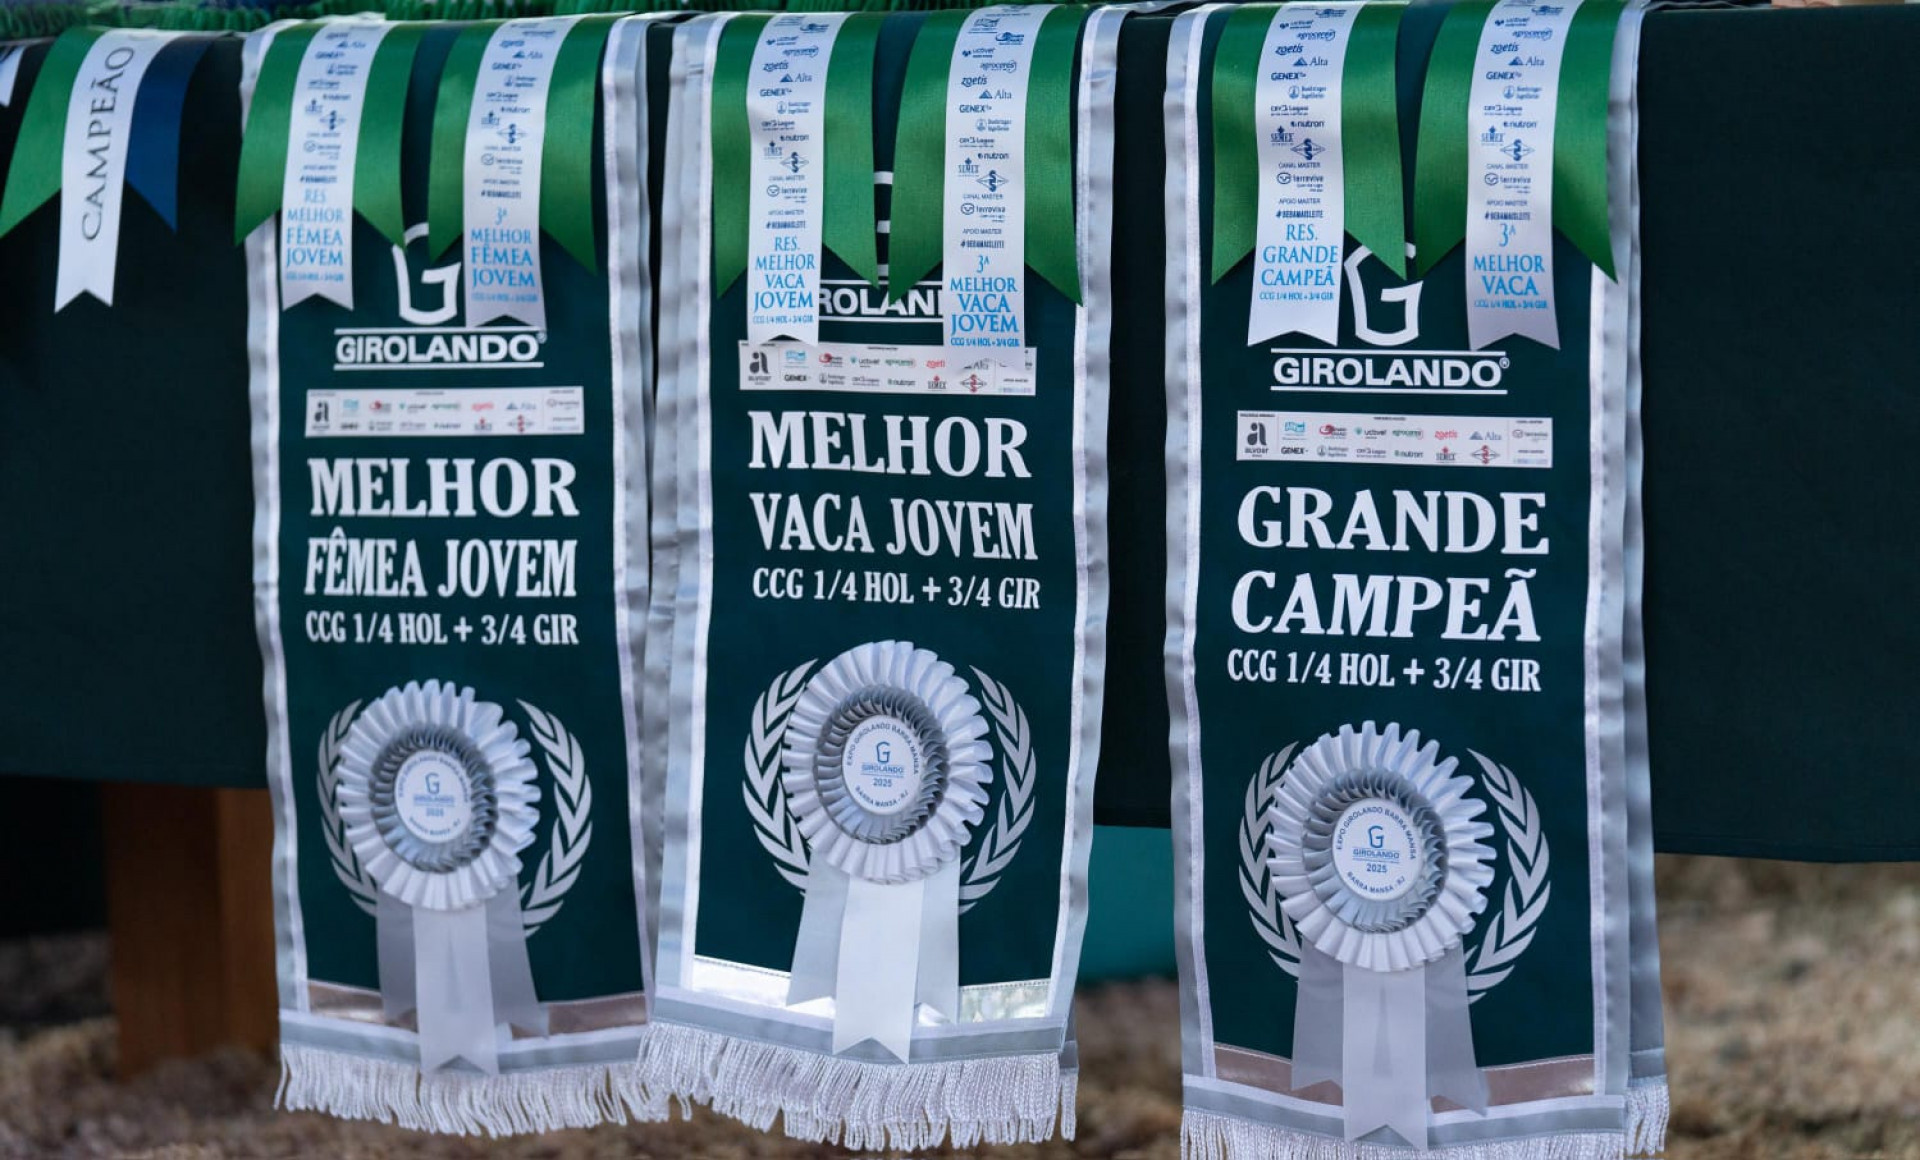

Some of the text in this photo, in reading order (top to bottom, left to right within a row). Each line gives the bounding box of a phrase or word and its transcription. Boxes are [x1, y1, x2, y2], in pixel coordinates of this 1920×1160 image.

[1490, 42, 1519, 54] zoetis
[1309, 57, 1328, 66] Alta
[1525, 56, 1544, 66] Alta
[1486, 71, 1514, 80] GENEX
[994, 89, 1012, 99] Alta
[82, 47, 135, 241] CAMPEÃO
[287, 208, 344, 222] MELHOR
[286, 224, 344, 245] FÊMEA
[470, 228, 532, 244] MELHOR
[1286, 224, 1318, 241] RES.
[286, 247, 344, 267] JOVEM
[470, 244, 534, 266] FÊMEA
[755, 254, 815, 270] MELHOR
[1262, 246, 1338, 263] GRANDE
[1474, 255, 1545, 272] MELHOR
[472, 267, 536, 288] JOVEM
[765, 274, 805, 289] VACA
[950, 277, 1018, 292] MELHOR
[1261, 265, 1335, 286] CAMPEÃ
[1482, 275, 1539, 295] VACA
[754, 291, 814, 312] JOVEM
[819, 287, 942, 315] ROLAN
[957, 294, 1010, 312] VACA
[951, 315, 1019, 335] JOVEM
[747, 411, 1032, 478] MELHOR
[307, 458, 580, 517] MELHOR
[749, 493, 1038, 560] VACA JOVEM
[1237, 485, 1549, 555] GRANDE
[304, 526, 578, 598] FÊMEA JOVEM
[753, 567, 1041, 609] CCG 1/4 HOL + 3/4 GIR
[1231, 567, 1541, 642] CAMPEÃ
[305, 611, 580, 645] CCG 1/4 HOL + 3/4 GIR
[1227, 648, 1542, 692] CCG 1/4 HOL + 3/4 GIR
[1353, 848, 1400, 859] GIROLANDO
[1366, 863, 1388, 873] 2025
